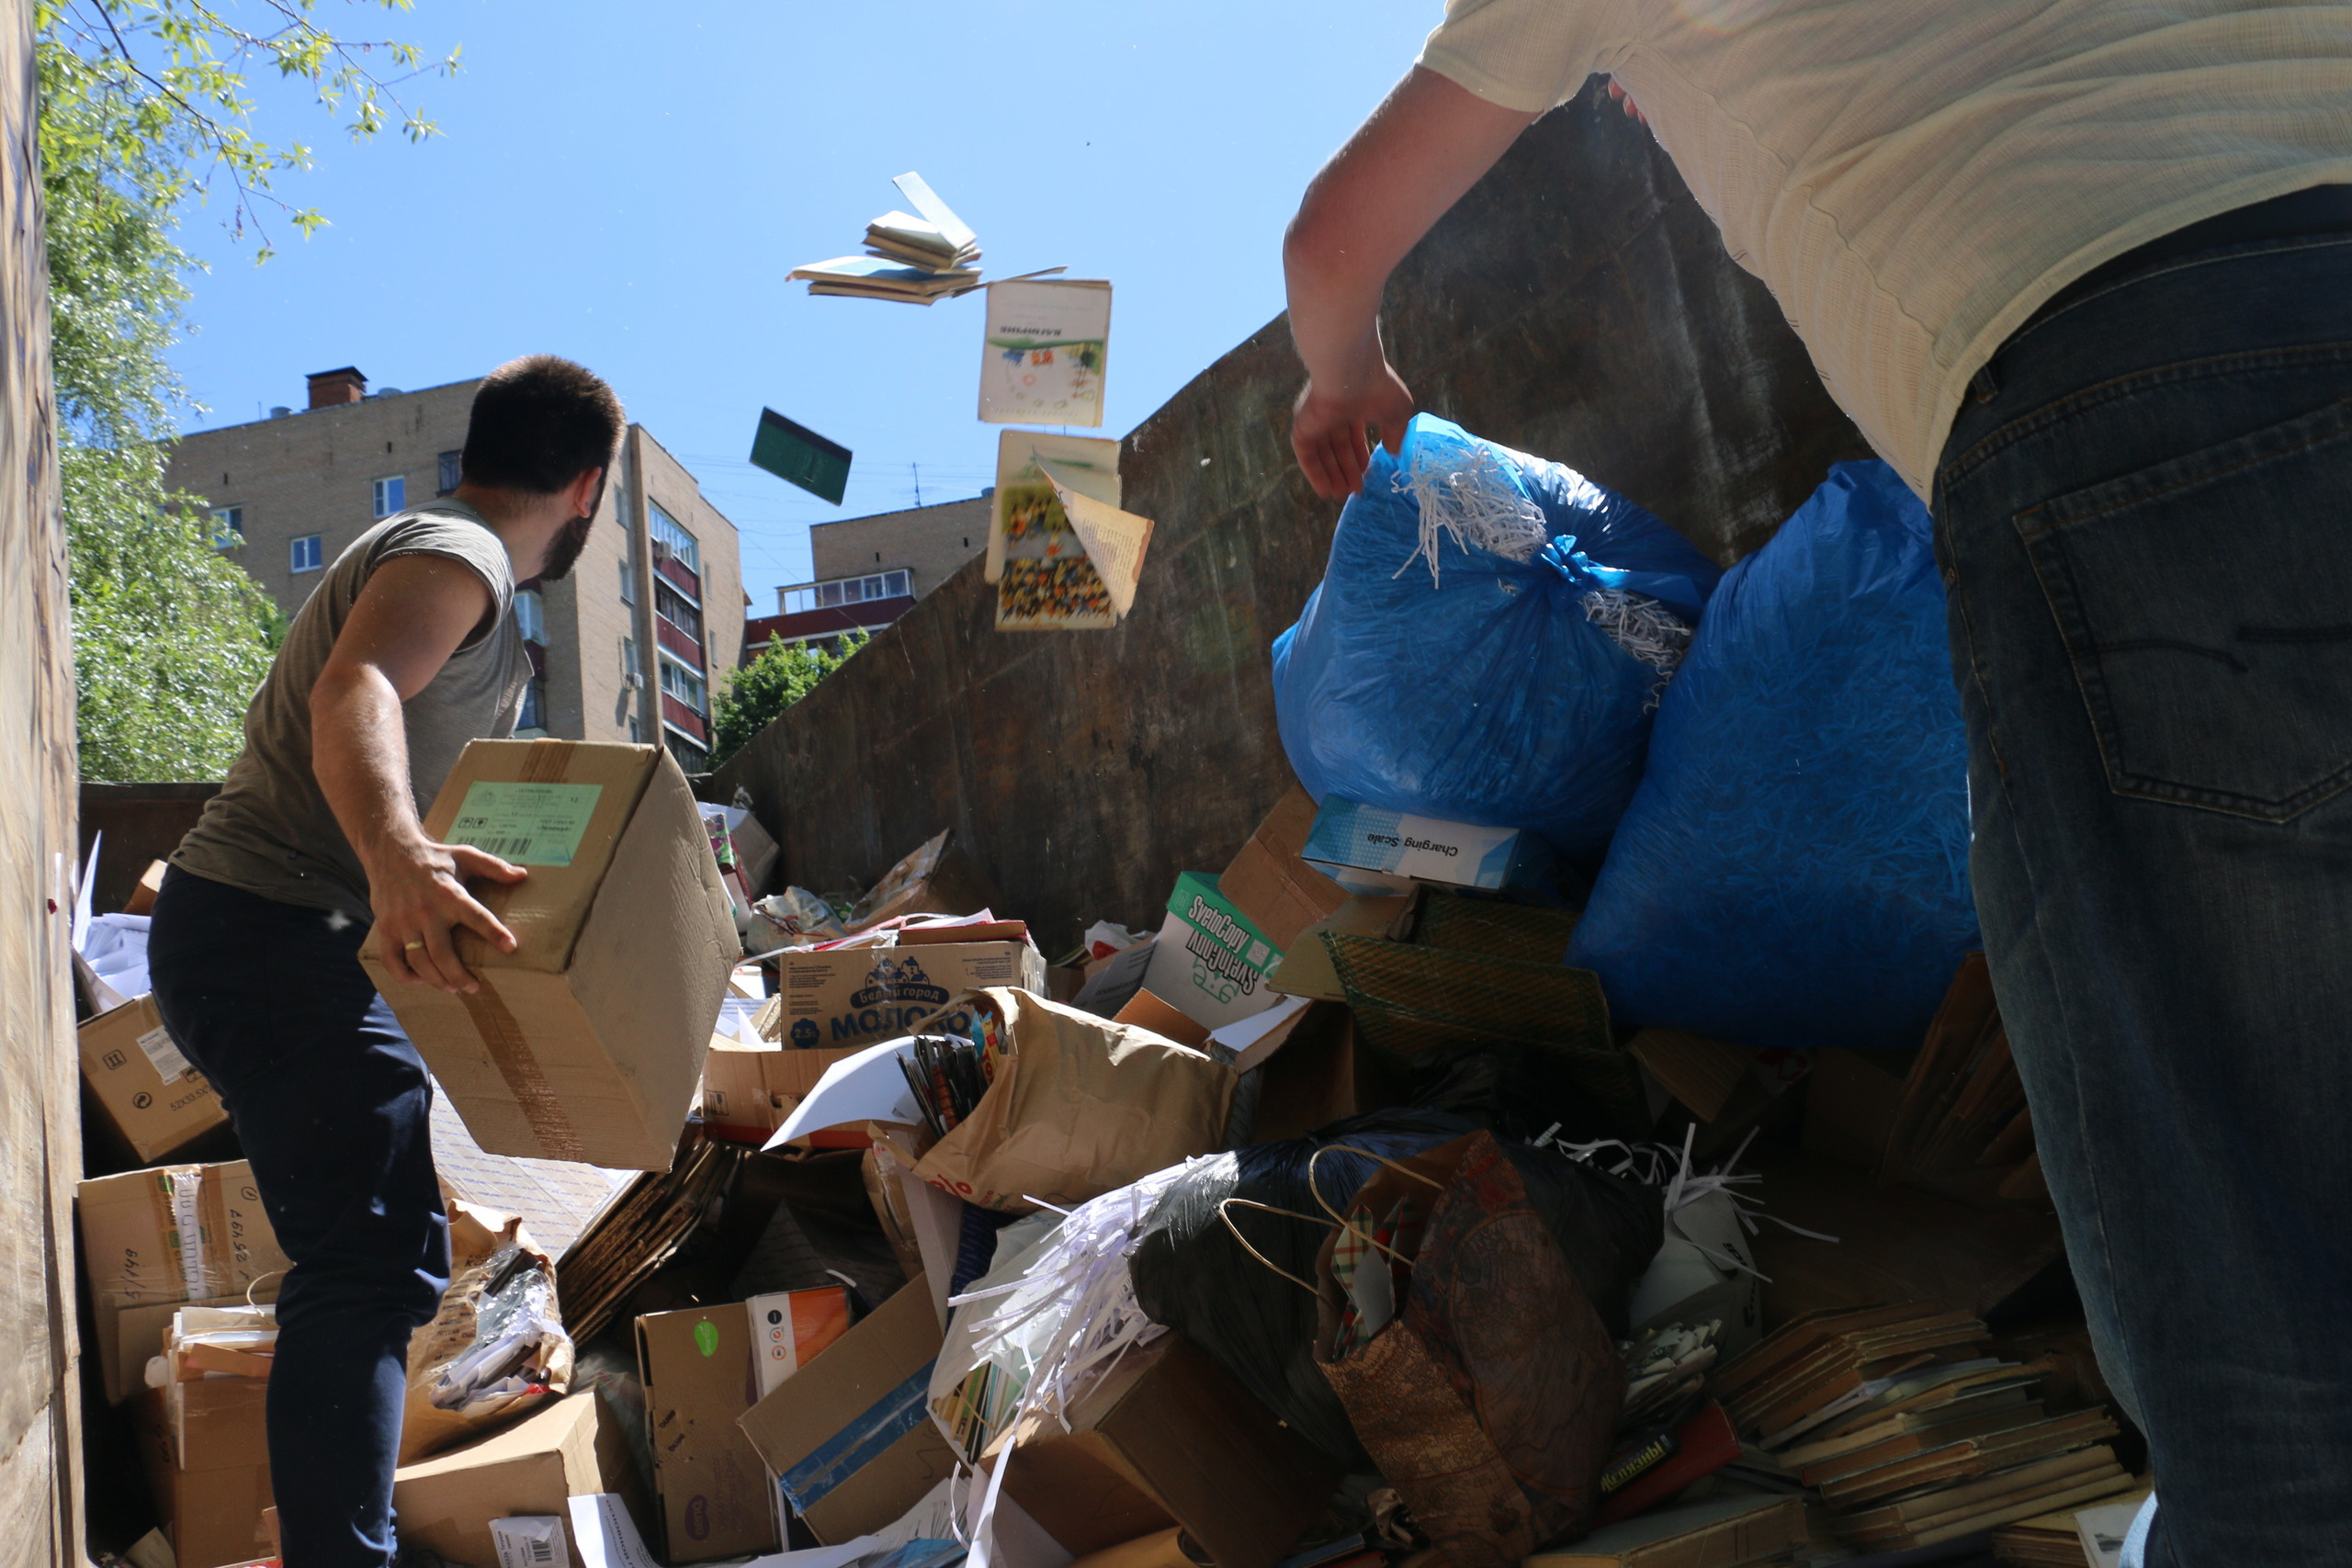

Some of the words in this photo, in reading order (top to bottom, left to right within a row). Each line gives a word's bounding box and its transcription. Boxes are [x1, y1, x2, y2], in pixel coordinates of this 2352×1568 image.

[1366, 830, 1399, 848] Scale
[1404, 834, 1459, 859] Charging
[1186, 892, 1250, 956] SvetoCopy
[859, 983, 900, 1004] Белый
[902, 987, 940, 1001] город
